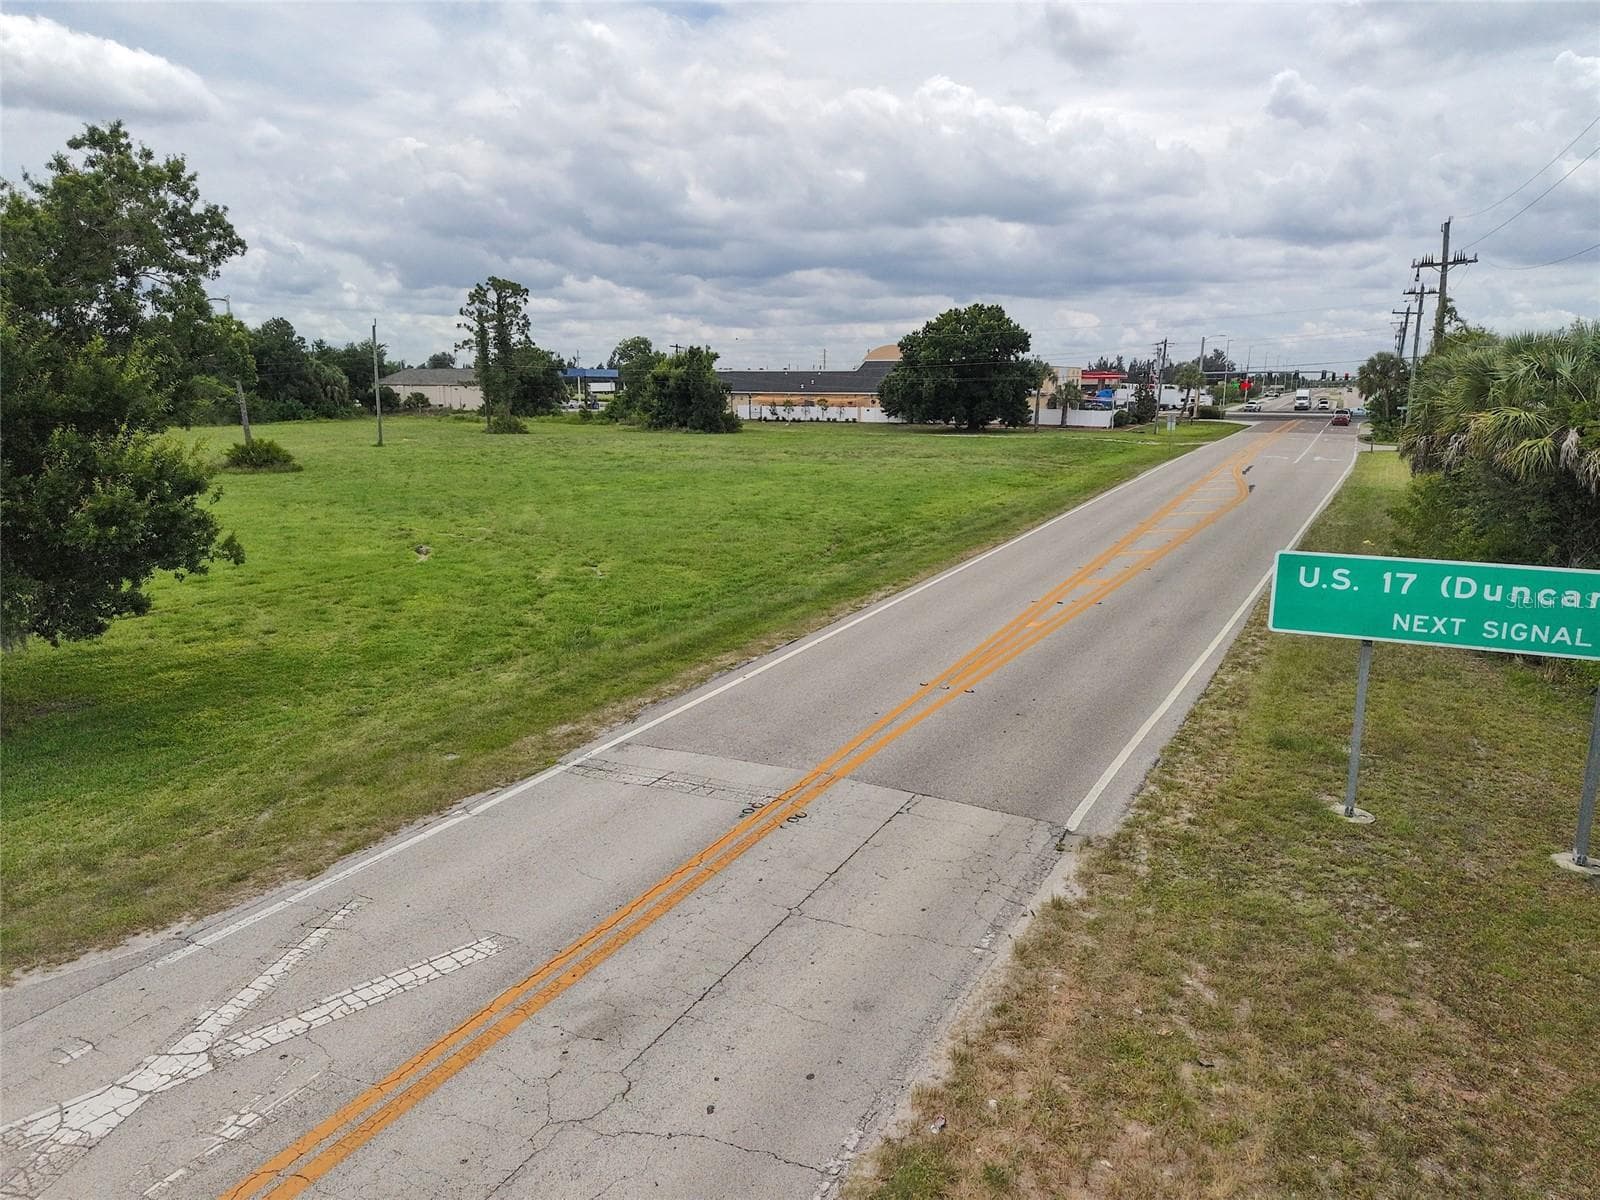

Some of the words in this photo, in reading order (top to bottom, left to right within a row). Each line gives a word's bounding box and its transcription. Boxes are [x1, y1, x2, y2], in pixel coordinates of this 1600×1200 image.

[1298, 566, 1359, 591] U.S.
[1383, 571, 1418, 595] 17
[1392, 613, 1467, 636] NEXT
[1482, 620, 1592, 647] SIGNAL
